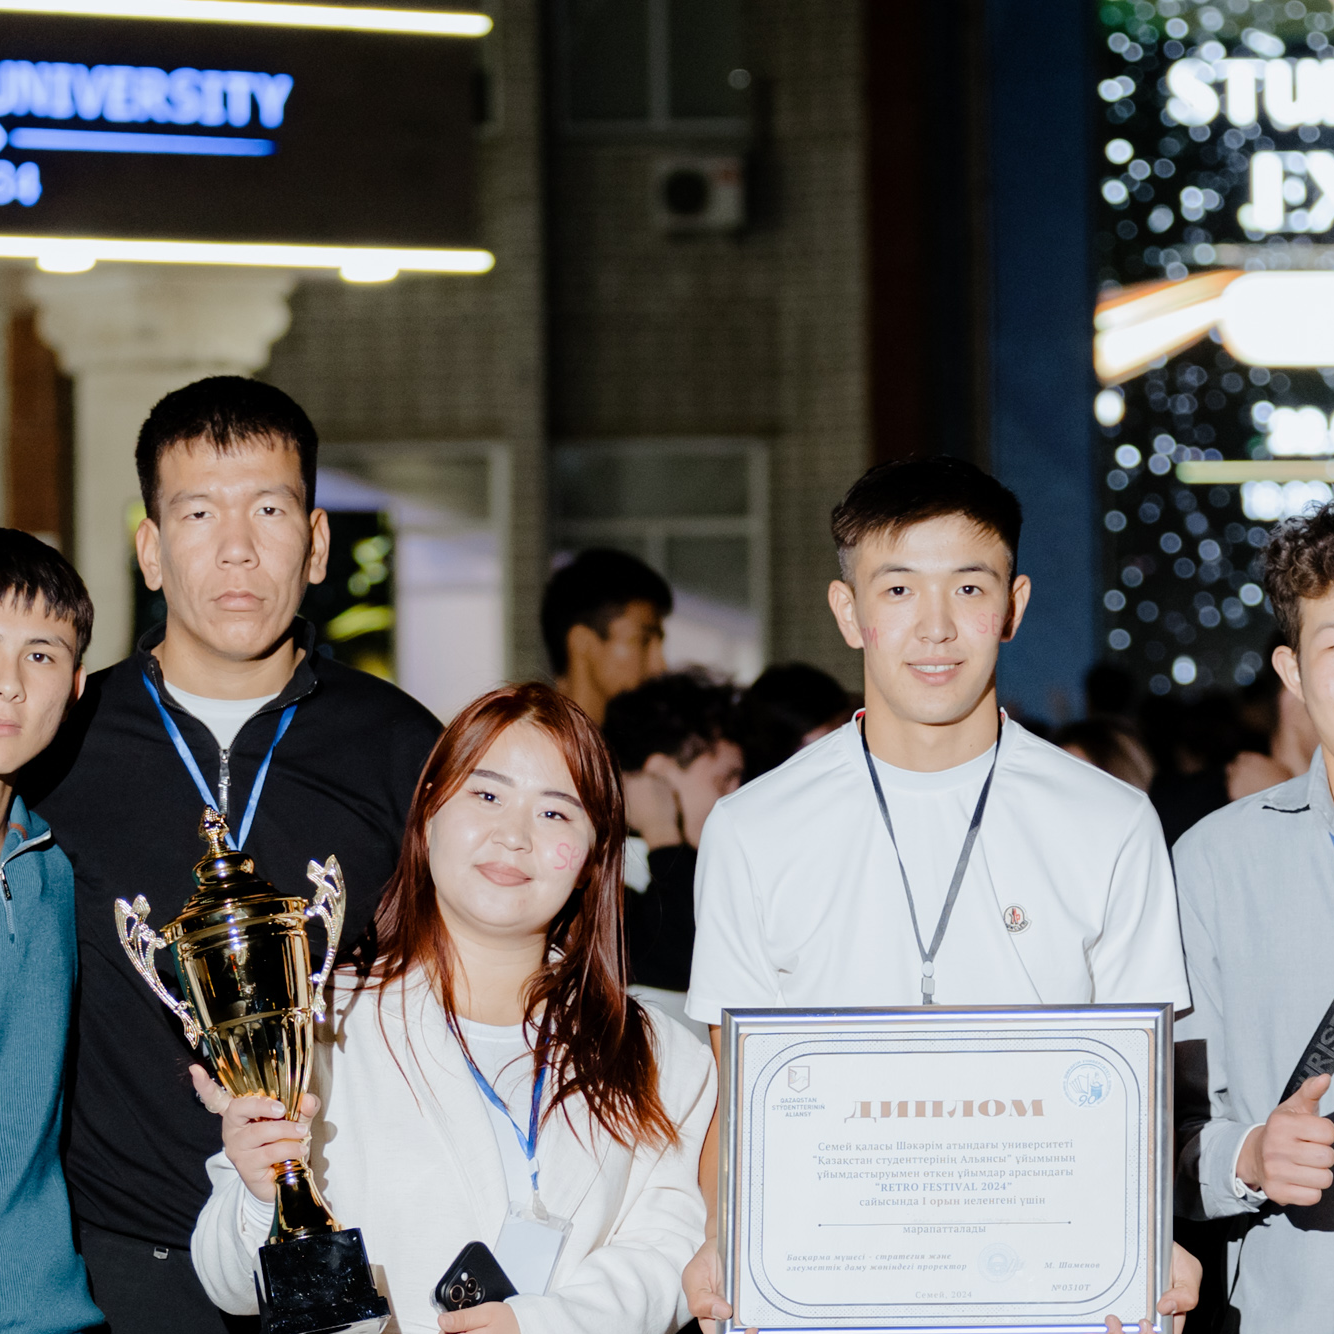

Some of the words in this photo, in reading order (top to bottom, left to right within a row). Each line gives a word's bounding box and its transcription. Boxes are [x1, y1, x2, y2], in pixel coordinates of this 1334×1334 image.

[844, 1099, 1044, 1123] ДИПЛОМ
[817, 1141, 852, 1152] Семей
[855, 1143, 893, 1152] қаласы
[896, 1140, 943, 1153] Шәкәрім
[945, 1141, 999, 1151] атындағы
[1001, 1138, 1074, 1152] университеті
[875, 1154, 958, 1167] студенттерінің
[1014, 1153, 1076, 1165] ұйымының
[816, 1169, 920, 1182] ұйымдастыруымен
[922, 1170, 955, 1178] өткен
[957, 1168, 1006, 1180] ұйымдар
[1008, 1168, 1074, 1179] арасындағы
[922, 1181, 978, 1192] FESTIVAL
[858, 1197, 920, 1207] сайысында
[929, 1198, 961, 1208] орын
[963, 1195, 1017, 1206] иеленгені
[1019, 1195, 1046, 1207] үшін
[902, 1225, 987, 1236] марапатталады
[786, 1253, 831, 1263] Басқарма
[833, 1253, 866, 1263] мүшесі
[874, 1254, 926, 1262] стратегия
[786, 1263, 842, 1273] әлеуметтік
[844, 1263, 867, 1273] даму
[869, 1262, 915, 1271] жөніндегі
[916, 1263, 968, 1272] проректор
[1058, 1261, 1101, 1269] Шаменов
[914, 1290, 948, 1300] Семей,
[950, 1290, 973, 1299] 2024
